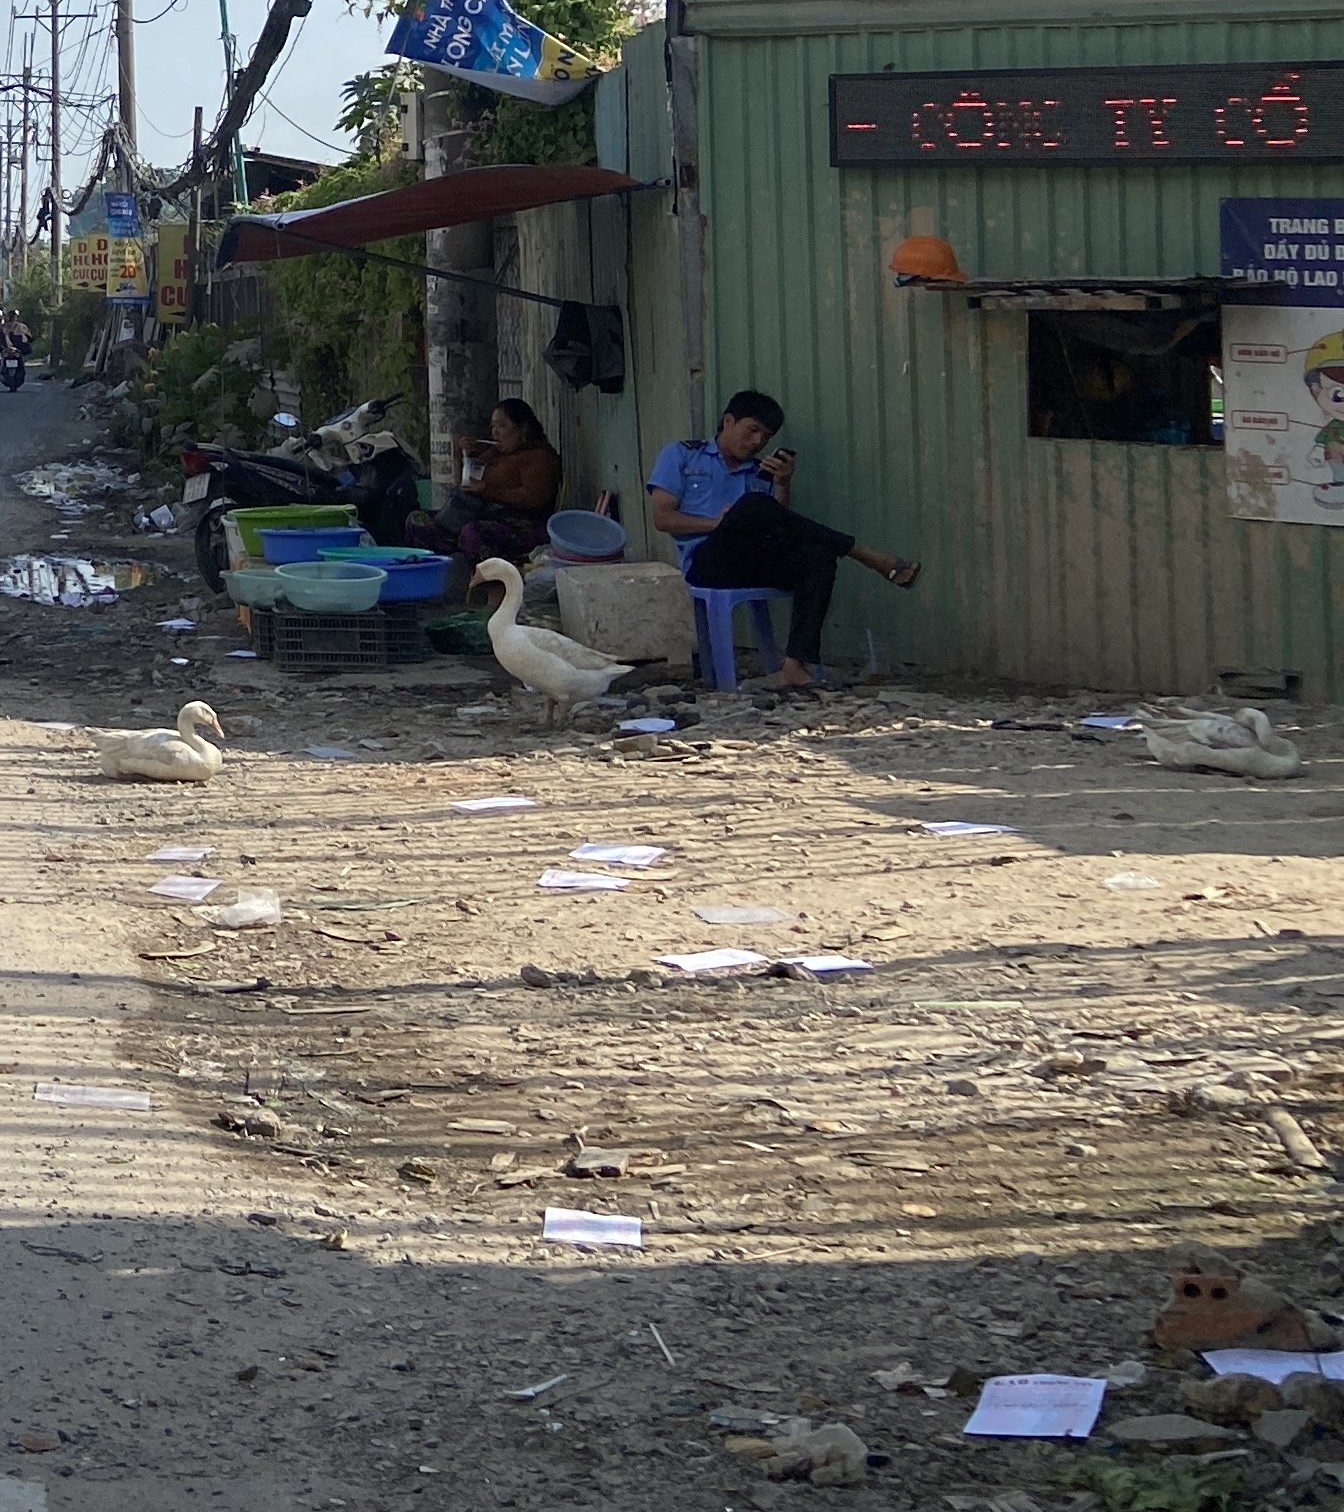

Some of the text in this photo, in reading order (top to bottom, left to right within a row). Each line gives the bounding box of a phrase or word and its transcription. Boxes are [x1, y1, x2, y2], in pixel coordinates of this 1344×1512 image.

[1104, 97, 1178, 147] TY
[1268, 218, 1329, 235] TRANG
[1303, 270, 1338, 287] LAO
